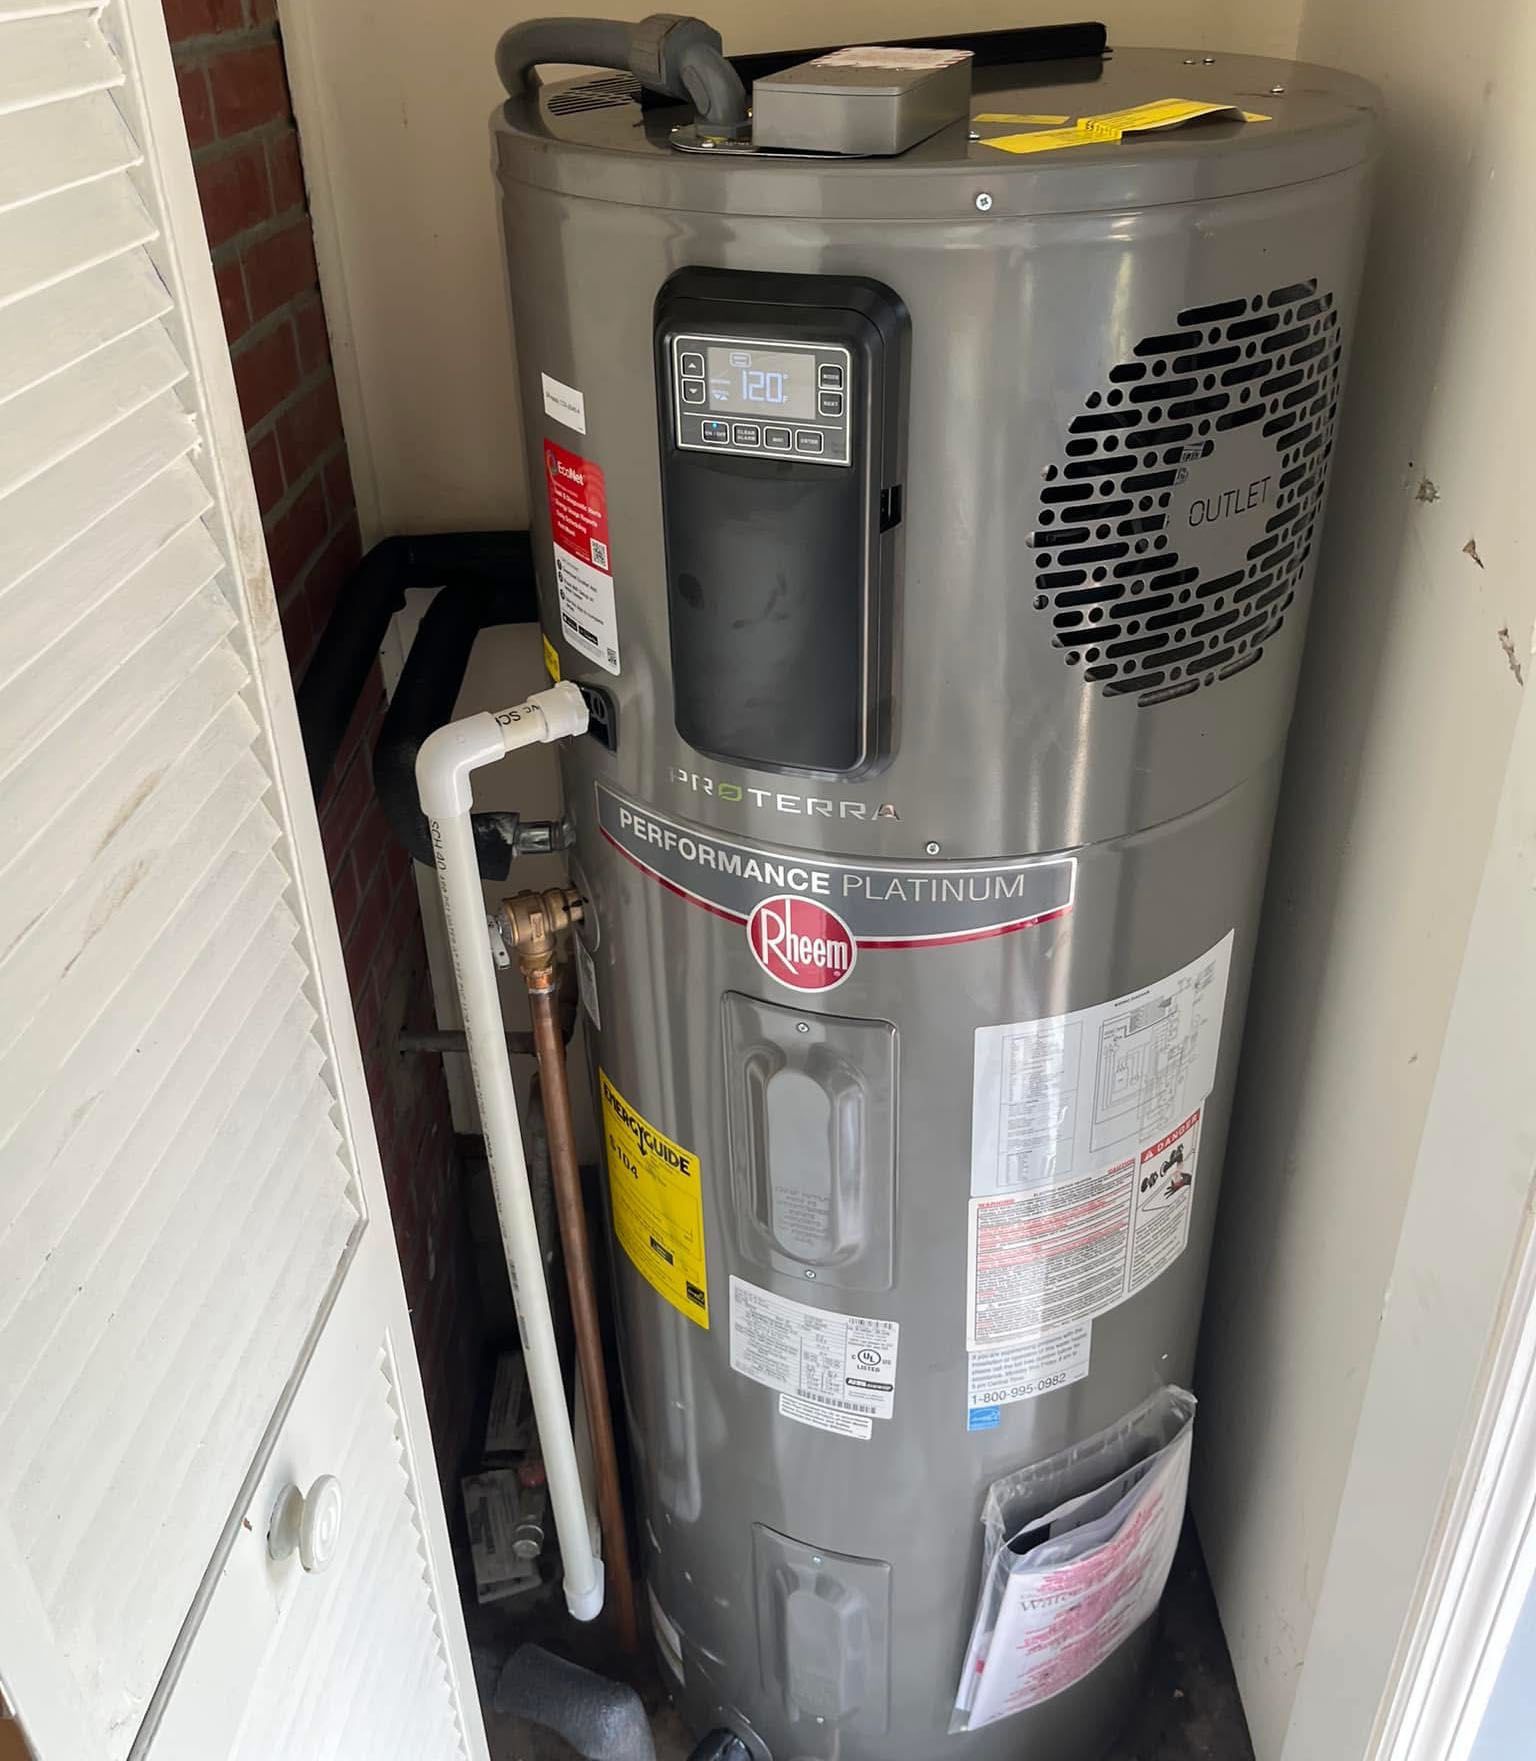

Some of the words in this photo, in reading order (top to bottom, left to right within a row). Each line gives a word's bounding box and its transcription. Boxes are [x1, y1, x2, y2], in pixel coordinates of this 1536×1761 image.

[741, 369, 784, 403] 120
[557, 460, 584, 486] EcoNet
[1189, 476, 1272, 527] OUTLET
[668, 767, 904, 824] PROTERRA
[619, 807, 831, 897] PERFORMANCE
[842, 872, 1025, 905] PLATINUM
[759, 898, 849, 976] Rheem
[603, 1081, 692, 1177] ENERGYGUIDE
[856, 1364, 881, 1374] LISTED
[972, 1372, 1067, 1405] 1-800-995-0982
